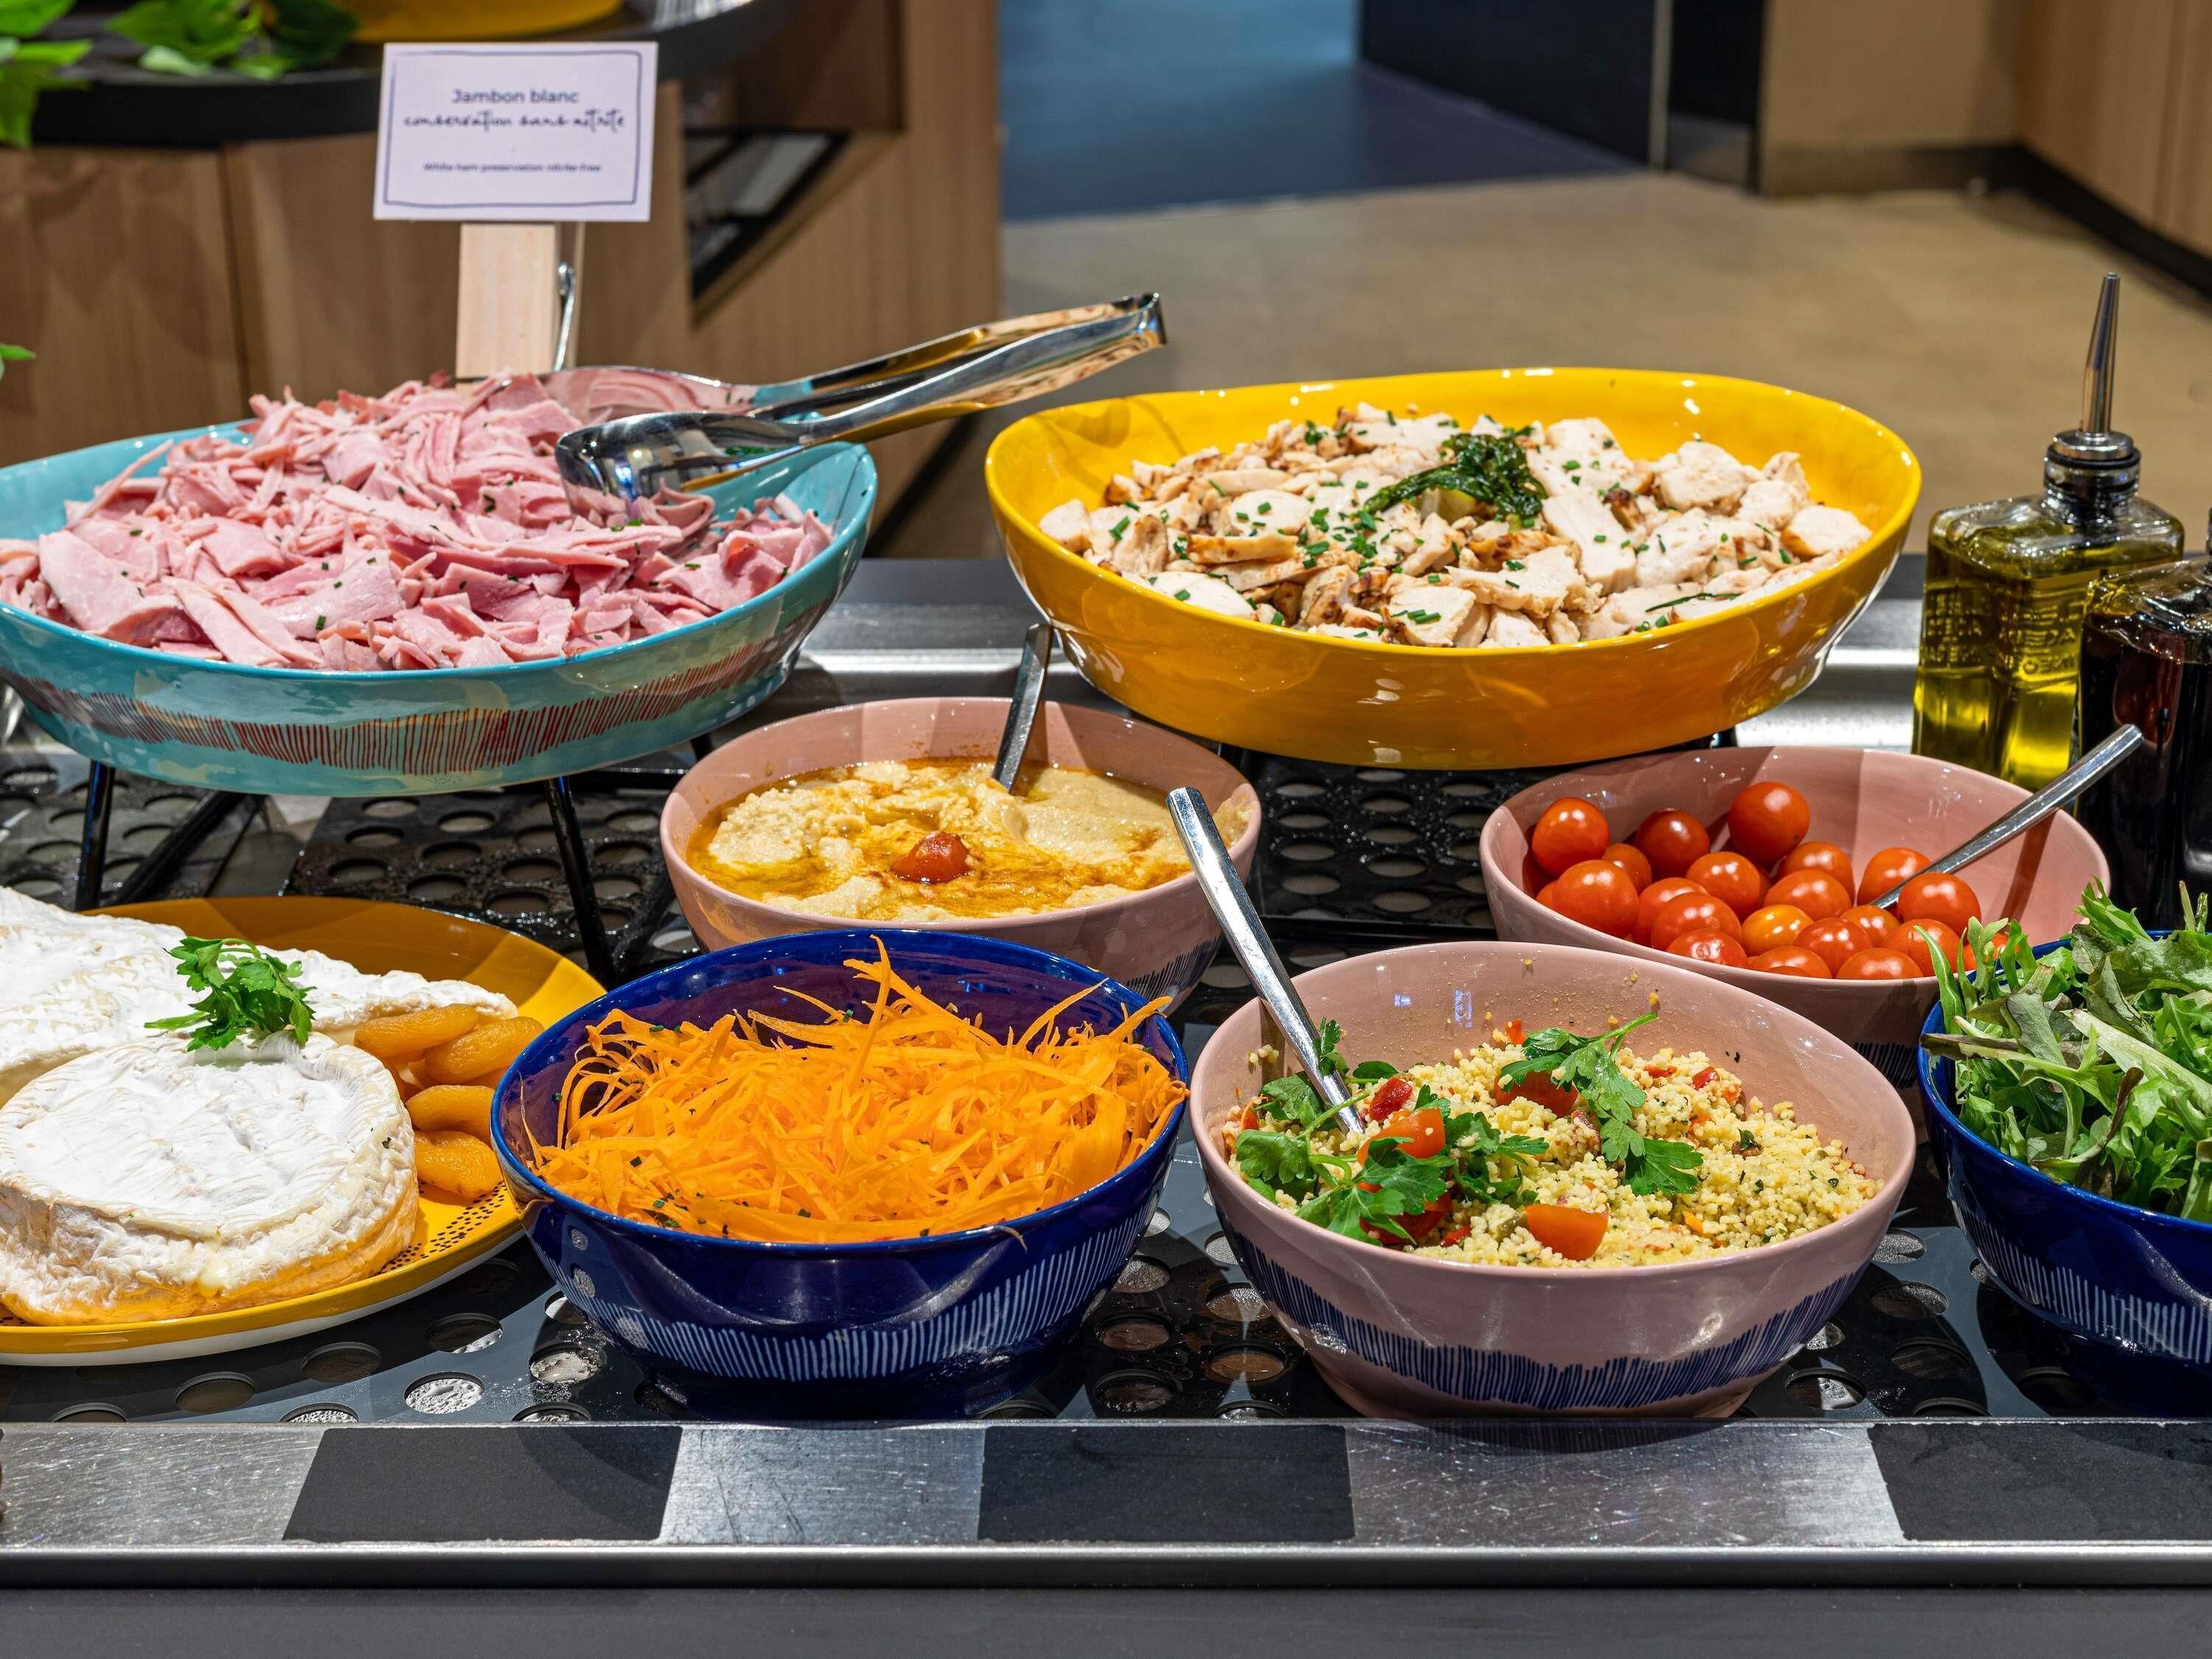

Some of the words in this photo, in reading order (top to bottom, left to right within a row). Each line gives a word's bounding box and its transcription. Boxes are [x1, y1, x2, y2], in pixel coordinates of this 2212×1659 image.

[452, 88, 525, 104] Jambon
[529, 89, 580, 104] blanc
[403, 109, 514, 133] conservation
[518, 114, 568, 128] sans
[572, 108, 625, 133] nitrite
[423, 162, 453, 173] White
[455, 163, 479, 173] ham
[480, 163, 544, 174] preservation
